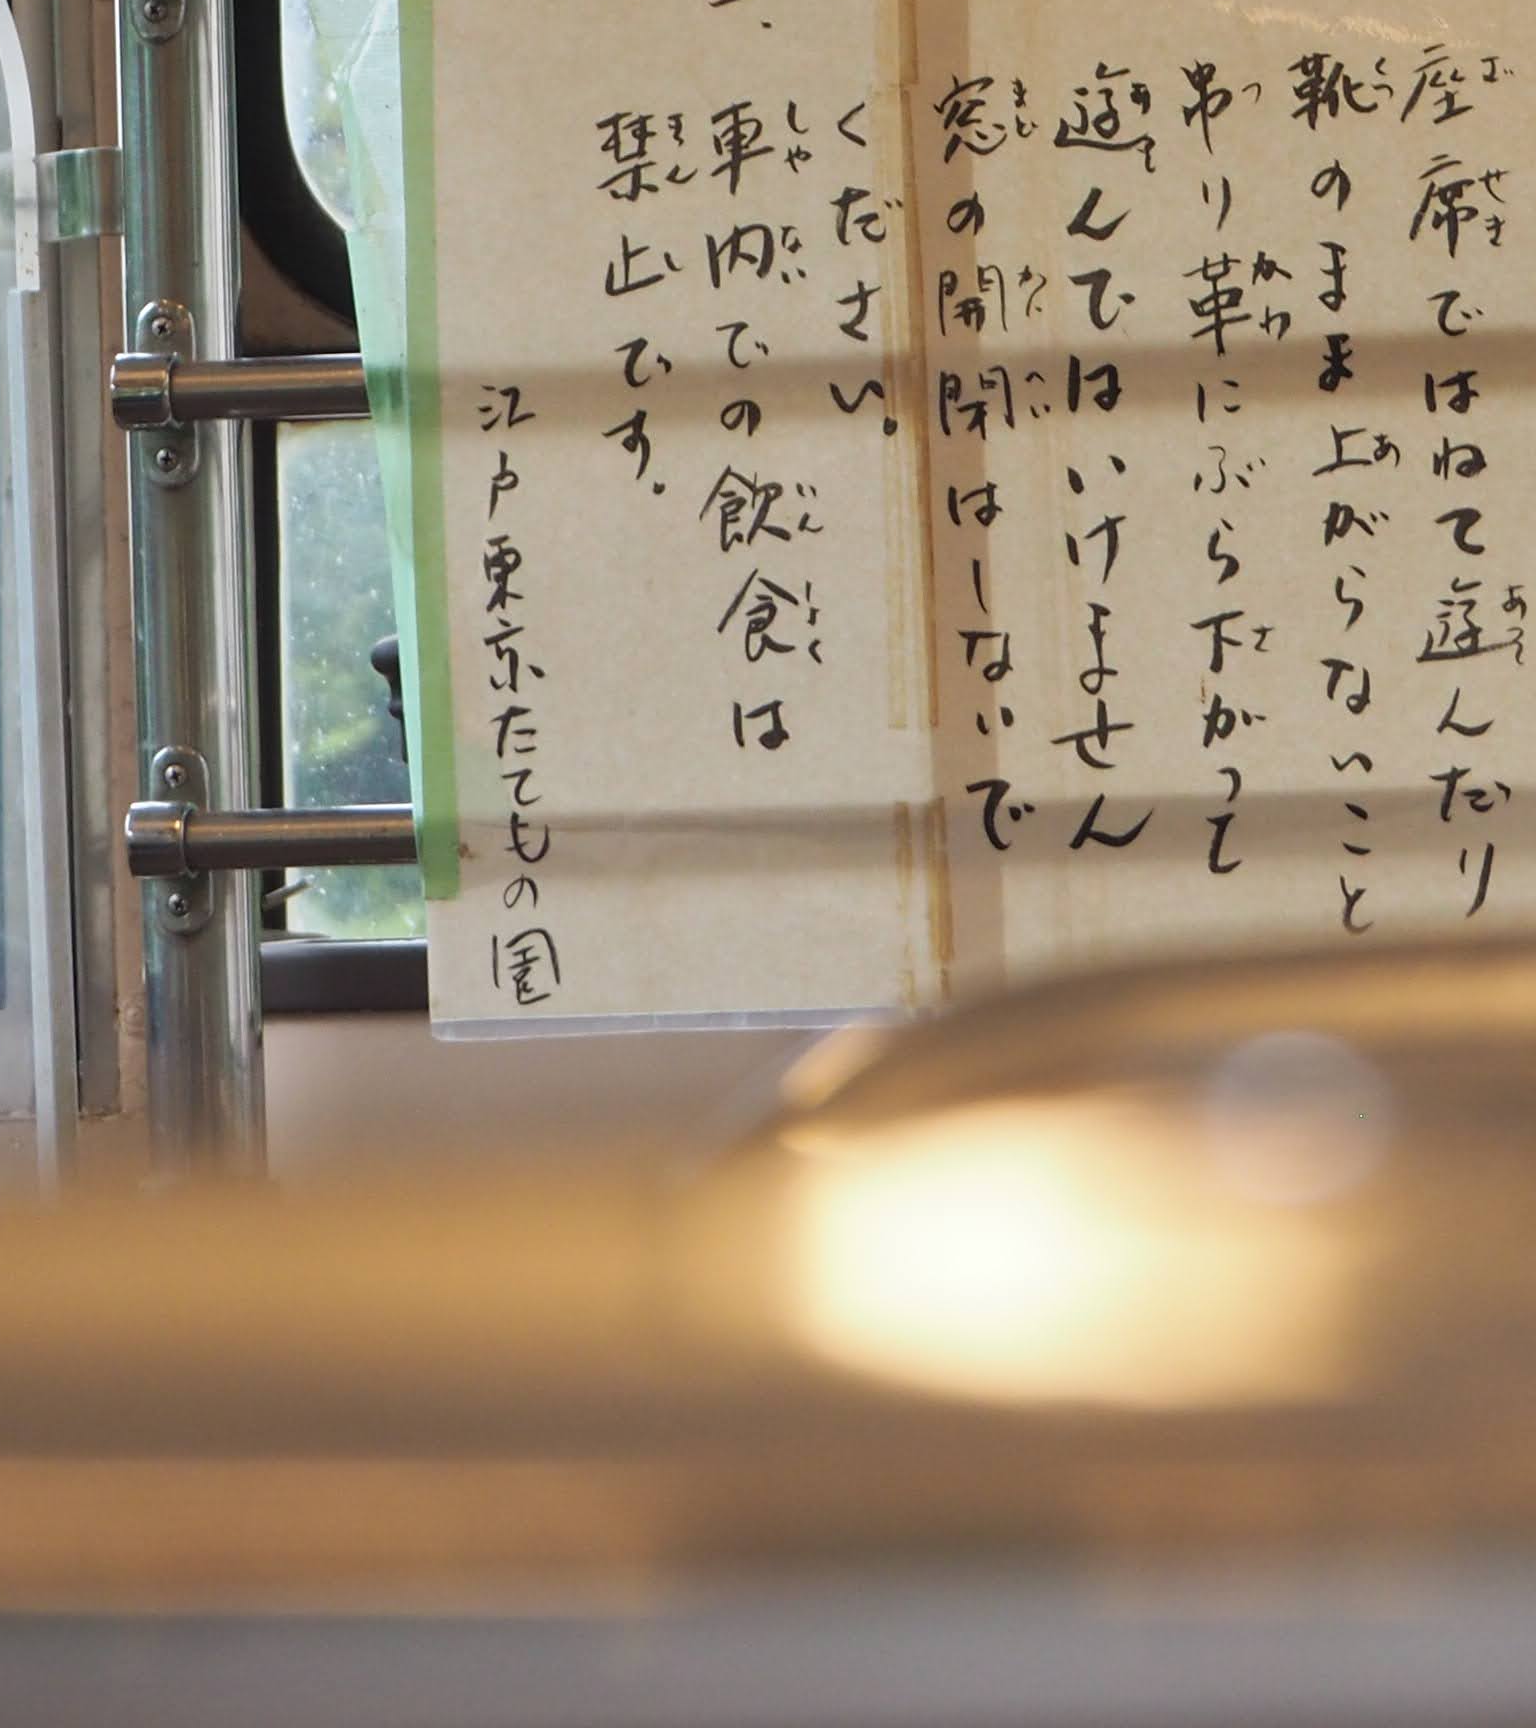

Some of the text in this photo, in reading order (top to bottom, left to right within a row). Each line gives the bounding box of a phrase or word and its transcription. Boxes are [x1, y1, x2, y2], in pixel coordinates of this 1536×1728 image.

[699, 101, 799, 751] 車内での飲食は
